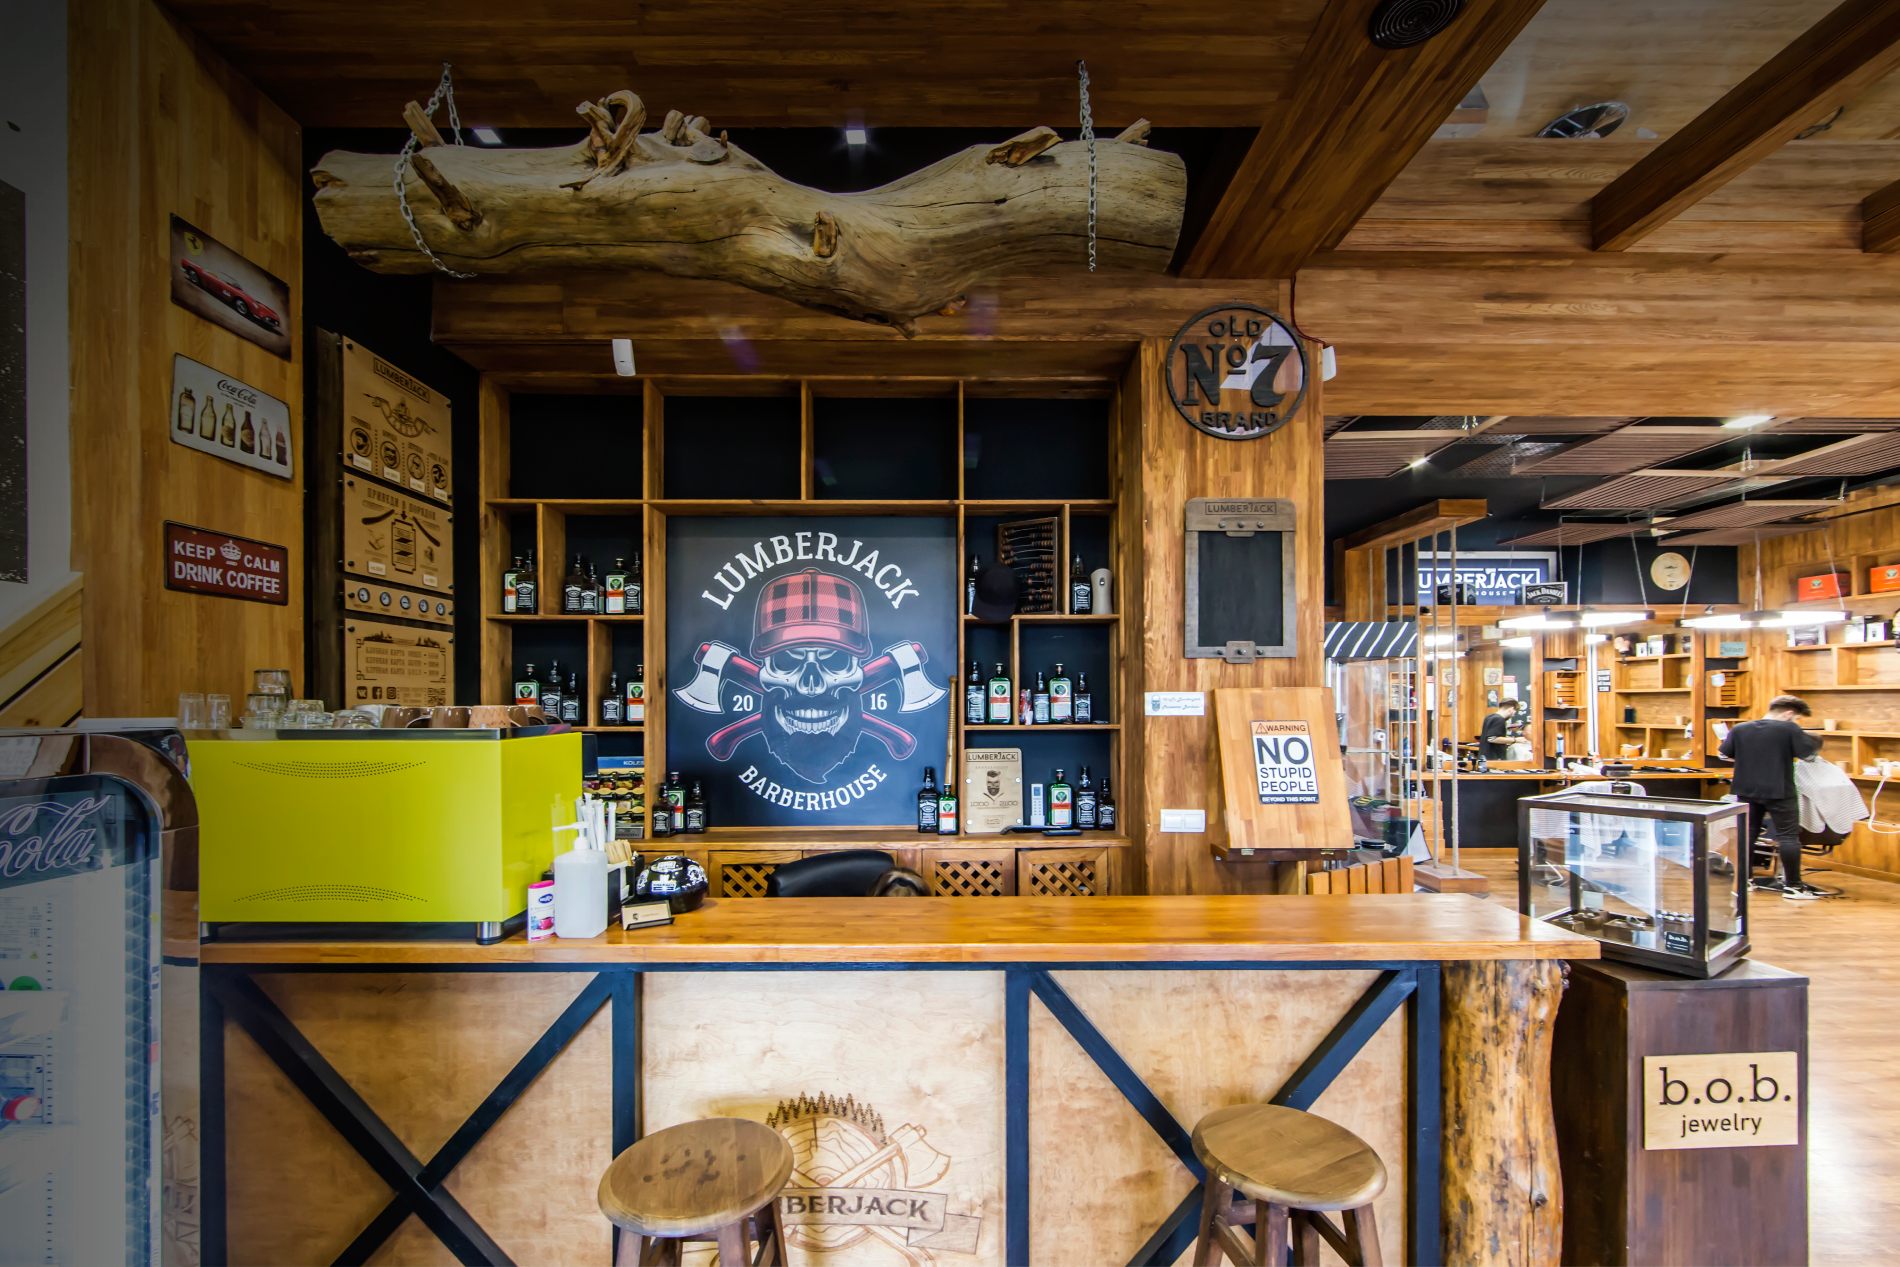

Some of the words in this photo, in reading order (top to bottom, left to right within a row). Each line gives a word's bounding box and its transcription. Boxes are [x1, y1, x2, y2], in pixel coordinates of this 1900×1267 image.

[1208, 314, 1261, 338] OLD
[374, 361, 429, 399] LUMBERJACK
[1201, 411, 1278, 434] BRAND
[1207, 502, 1275, 514] LUMBERJACK
[174, 539, 217, 561] KEEP
[243, 554, 280, 574] CALM
[174, 560, 224, 587] DRINK
[226, 570, 280, 595] COFFEE
[701, 531, 920, 611] LUMBERJACK
[732, 694, 754, 712] 20
[870, 693, 888, 711] 16
[1266, 724, 1306, 732] WARNING
[968, 752, 1016, 761] LUMBERJACK
[1256, 737, 1310, 765] NO
[1260, 767, 1312, 779] STUPID
[738, 763, 888, 811] BARBERHOUSE
[1261, 781, 1315, 792] PEOPLE
[1658, 1063, 1791, 1105] b.o.b.
[1680, 1113, 1762, 1138] jewelry
[785, 1195, 930, 1222] BERJACK
